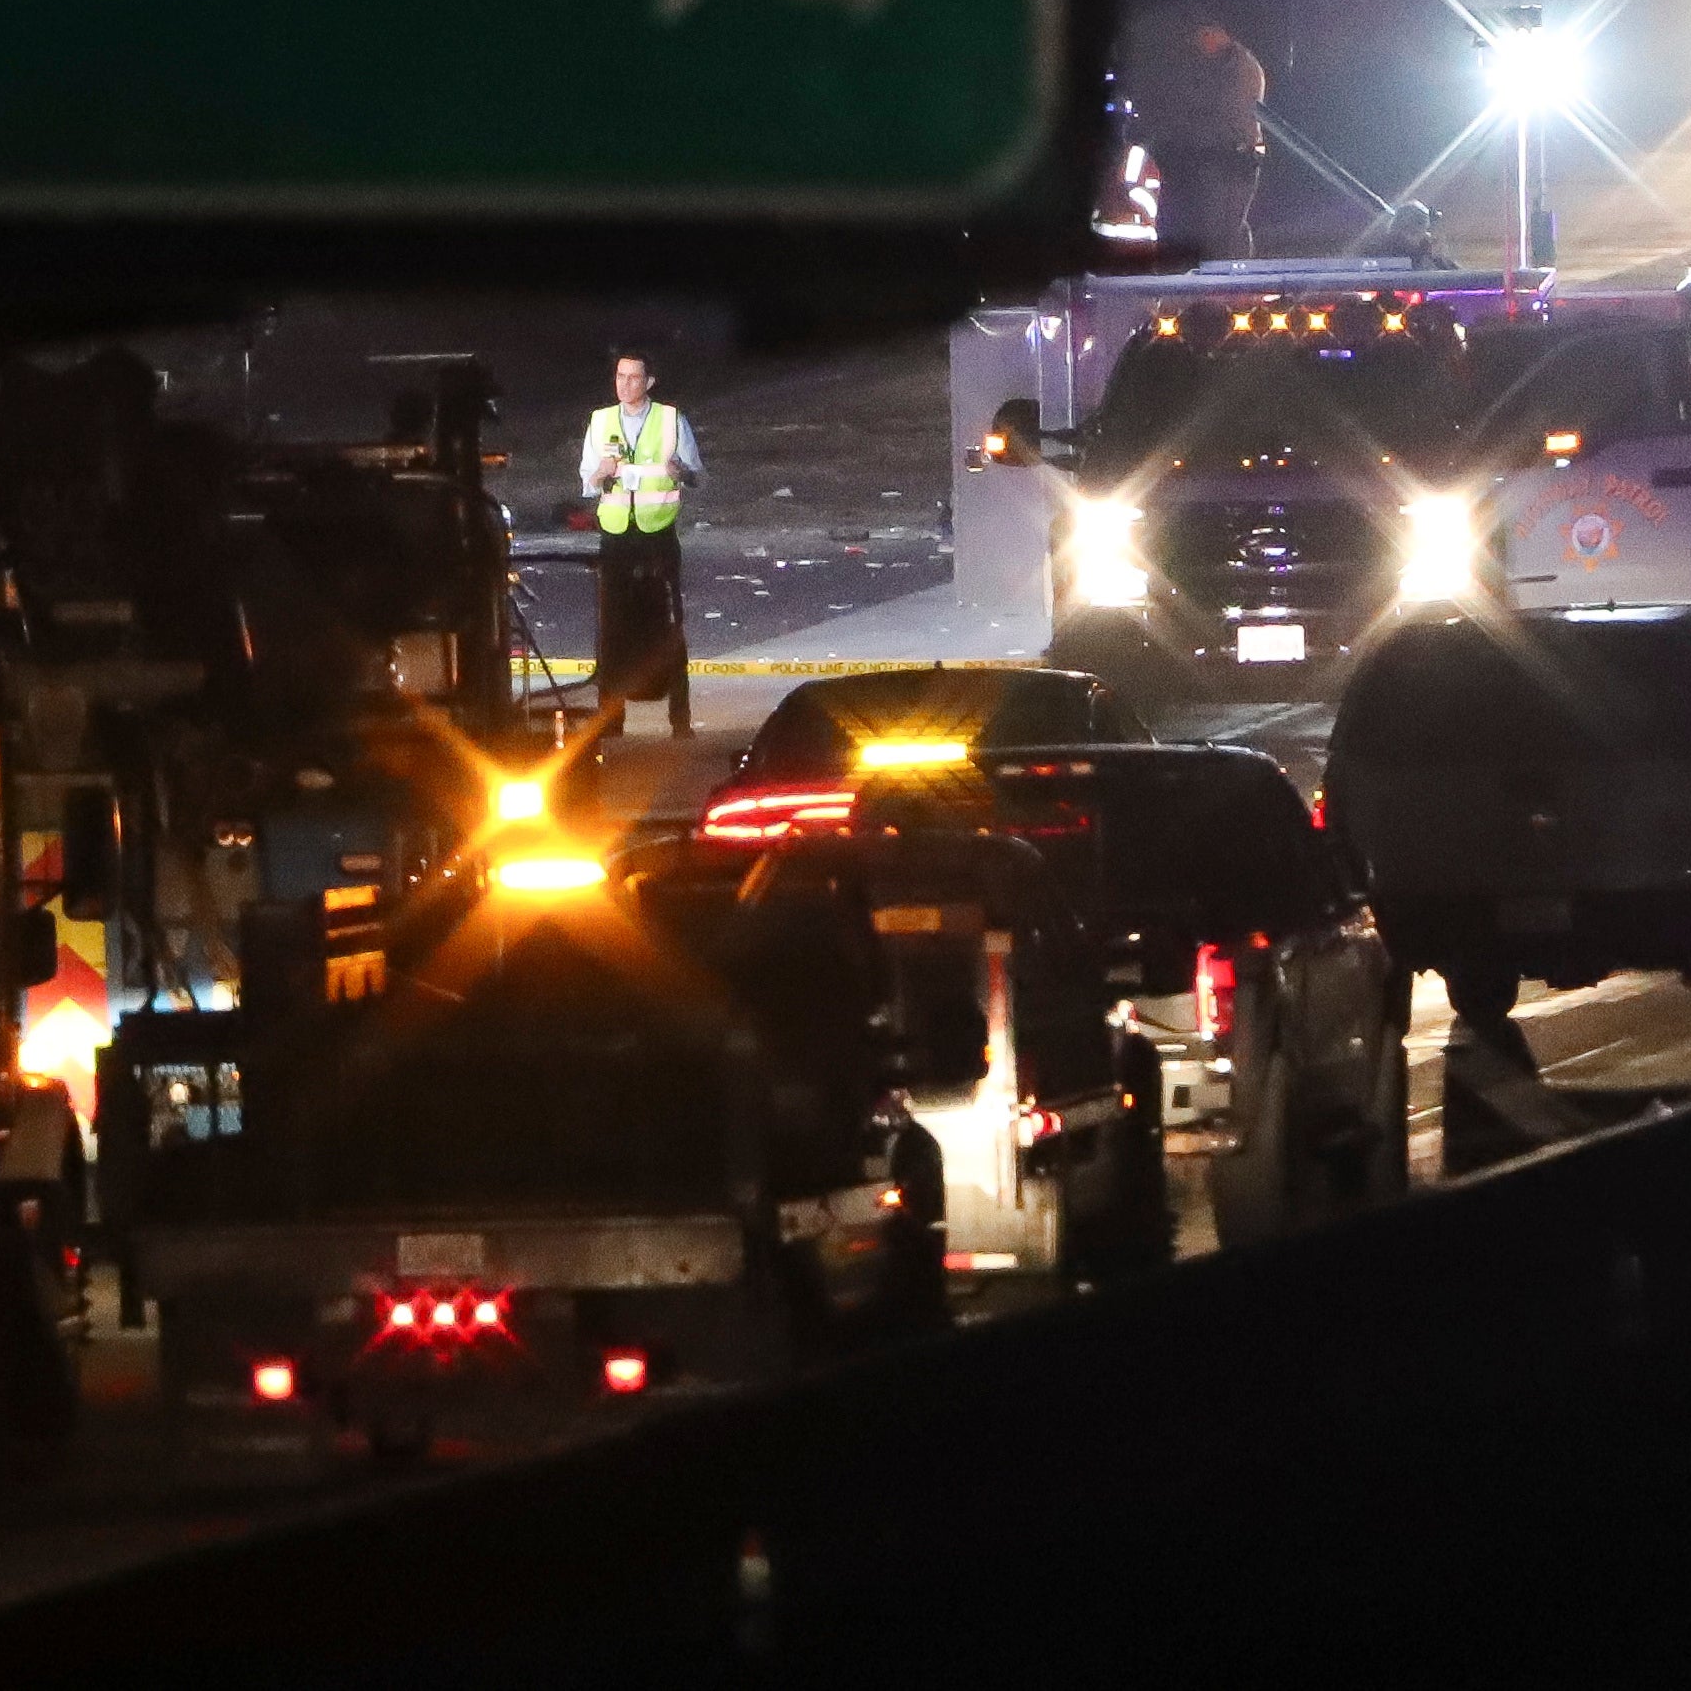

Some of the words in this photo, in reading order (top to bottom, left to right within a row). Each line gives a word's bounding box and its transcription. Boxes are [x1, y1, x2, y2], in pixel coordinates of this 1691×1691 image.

[704, 662, 746, 674] CROSS
[770, 662, 813, 674] POLICE
[818, 662, 844, 673] LINE
